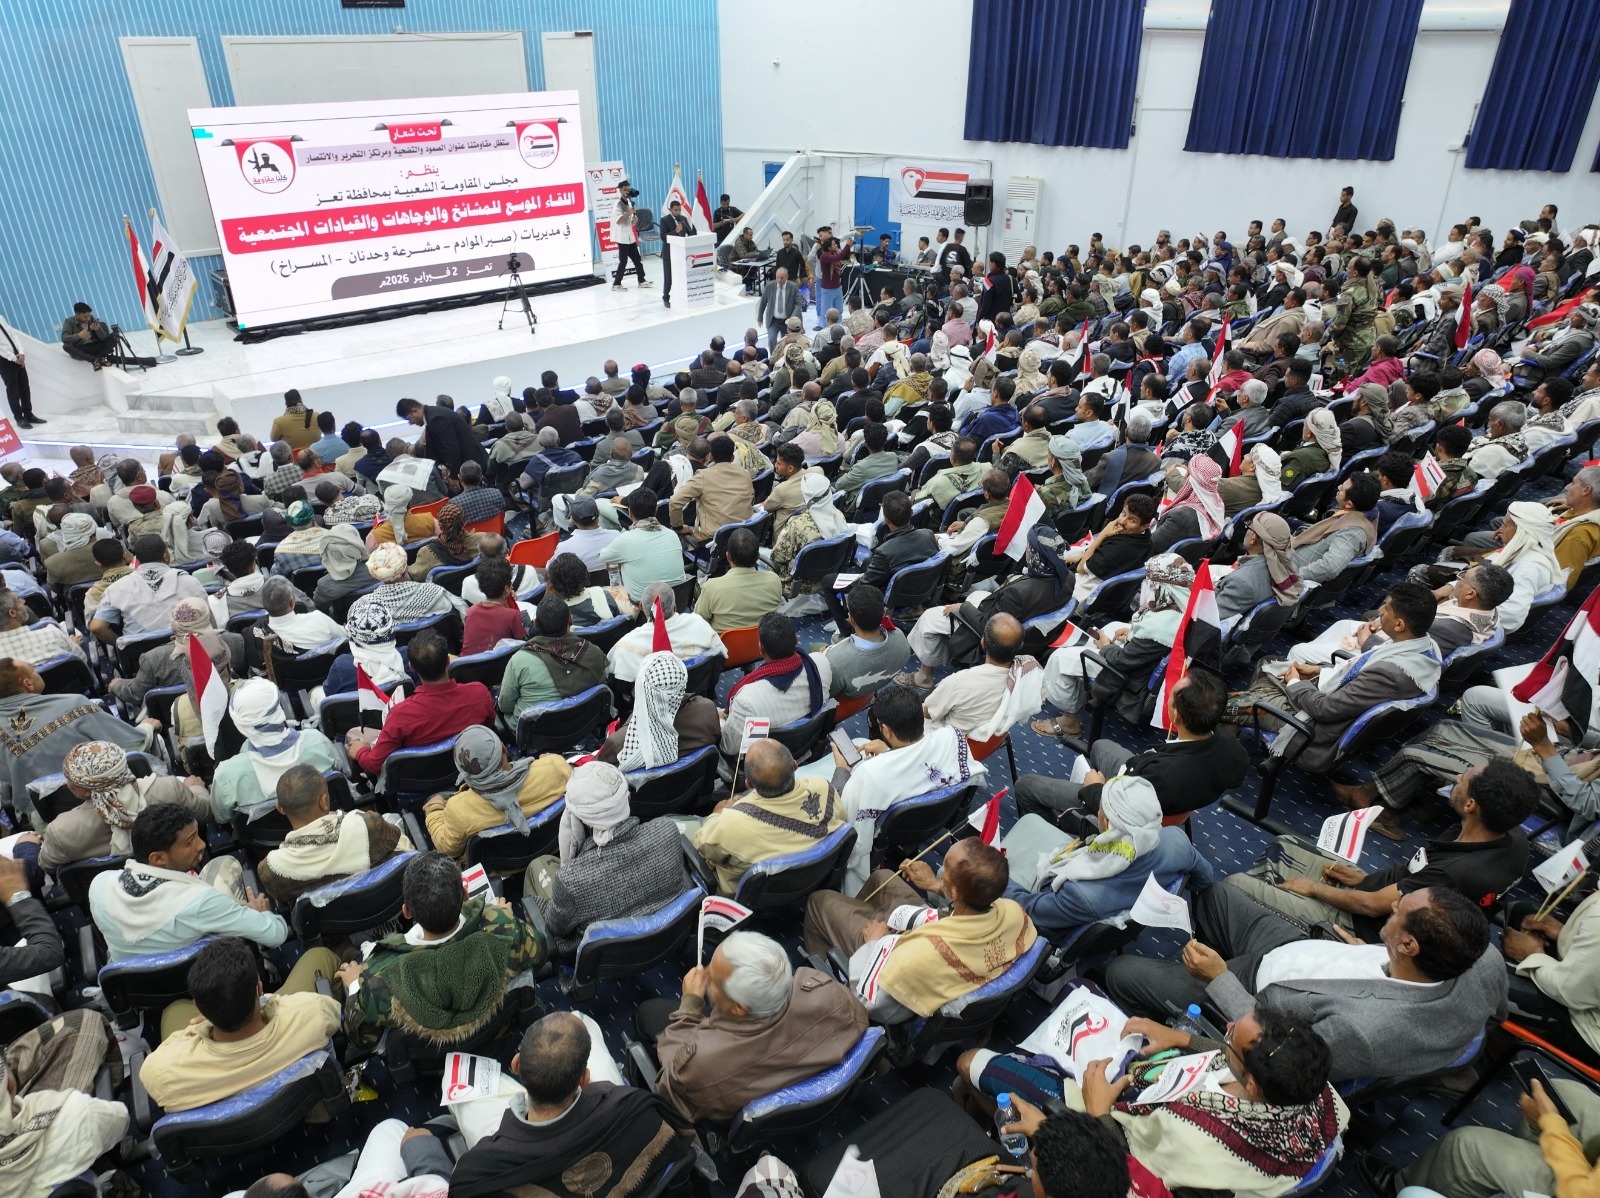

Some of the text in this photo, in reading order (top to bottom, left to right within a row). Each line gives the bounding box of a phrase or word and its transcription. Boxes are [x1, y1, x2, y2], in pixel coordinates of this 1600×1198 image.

[393, 126, 437, 141] تحت شعار
[306, 138, 510, 164] ستظل مقاومتنا عنوان الصمود والتضحية ومرتكز التحرير والانتصار
[315, 175, 519, 207] مجلس المقاومة الشعبية بمحافظة تعز
[545, 191, 576, 209] اللقاء
[382, 205, 449, 227] والوجاهات
[452, 200, 502, 222] للمشائخ
[238, 220, 310, 246] المجتمعية
[313, 213, 379, 235] والقيادات
[562, 222, 572, 240] في
[520, 228, 561, 242] مديريات
[349, 249, 390, 265] وحدنان
[392, 242, 441, 258] مشرعة
[413, 267, 451, 285] فبراير
[451, 266, 459, 277] 2
[465, 262, 493, 276] تعز
